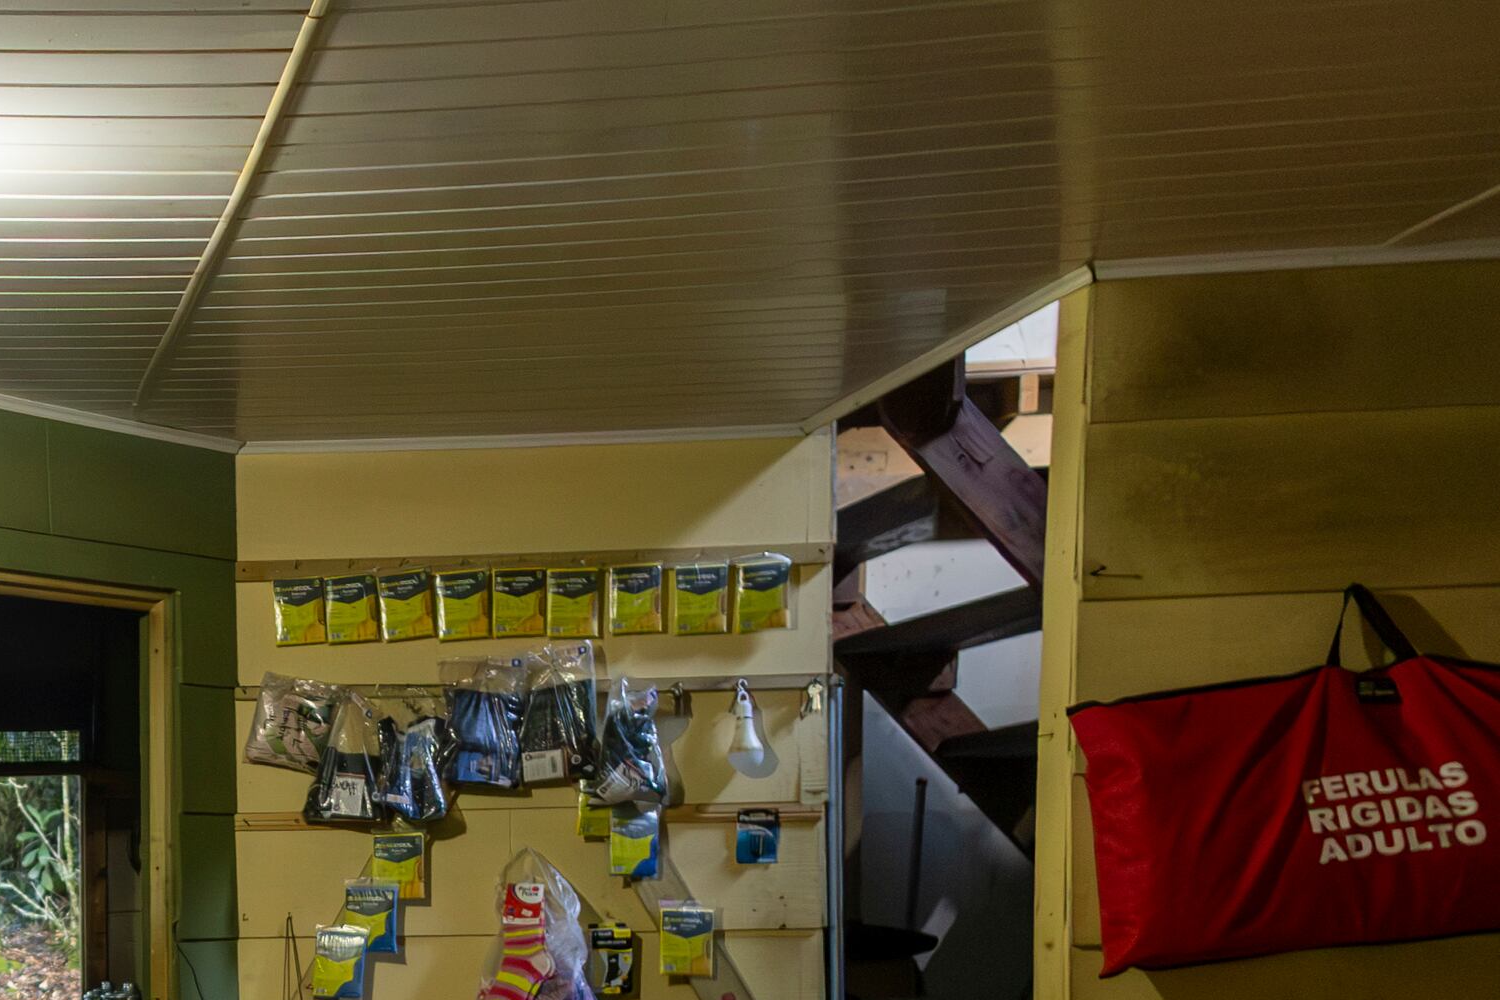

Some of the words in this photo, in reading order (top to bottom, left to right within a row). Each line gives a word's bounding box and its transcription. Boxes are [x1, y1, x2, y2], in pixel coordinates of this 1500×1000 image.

[1302, 760, 1469, 804] FERULAS
[1307, 790, 1480, 835] RIGIDAS
[1318, 819, 1488, 866] ADULTO
